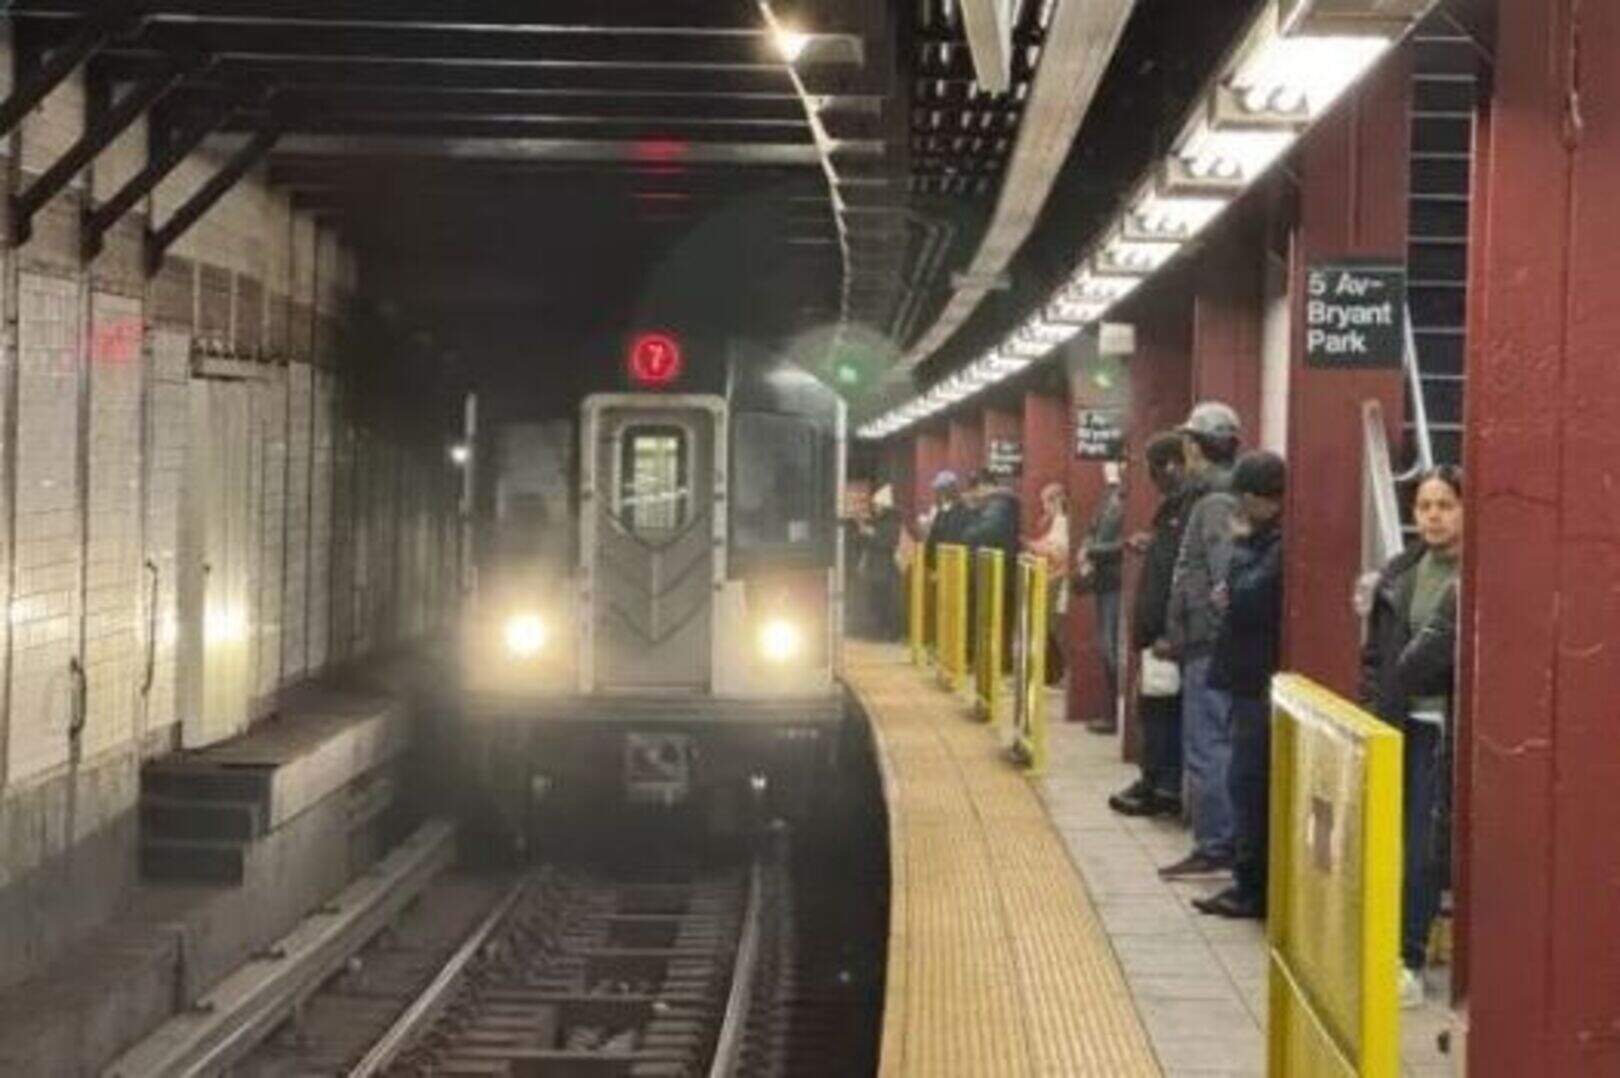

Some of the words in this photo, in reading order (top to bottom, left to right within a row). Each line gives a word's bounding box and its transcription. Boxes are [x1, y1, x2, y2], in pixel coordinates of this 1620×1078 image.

[1308, 272, 1327, 295] 5
[1308, 300, 1392, 329] Bryant
[1307, 329, 1367, 353] Park
[648, 344, 664, 370] 7
